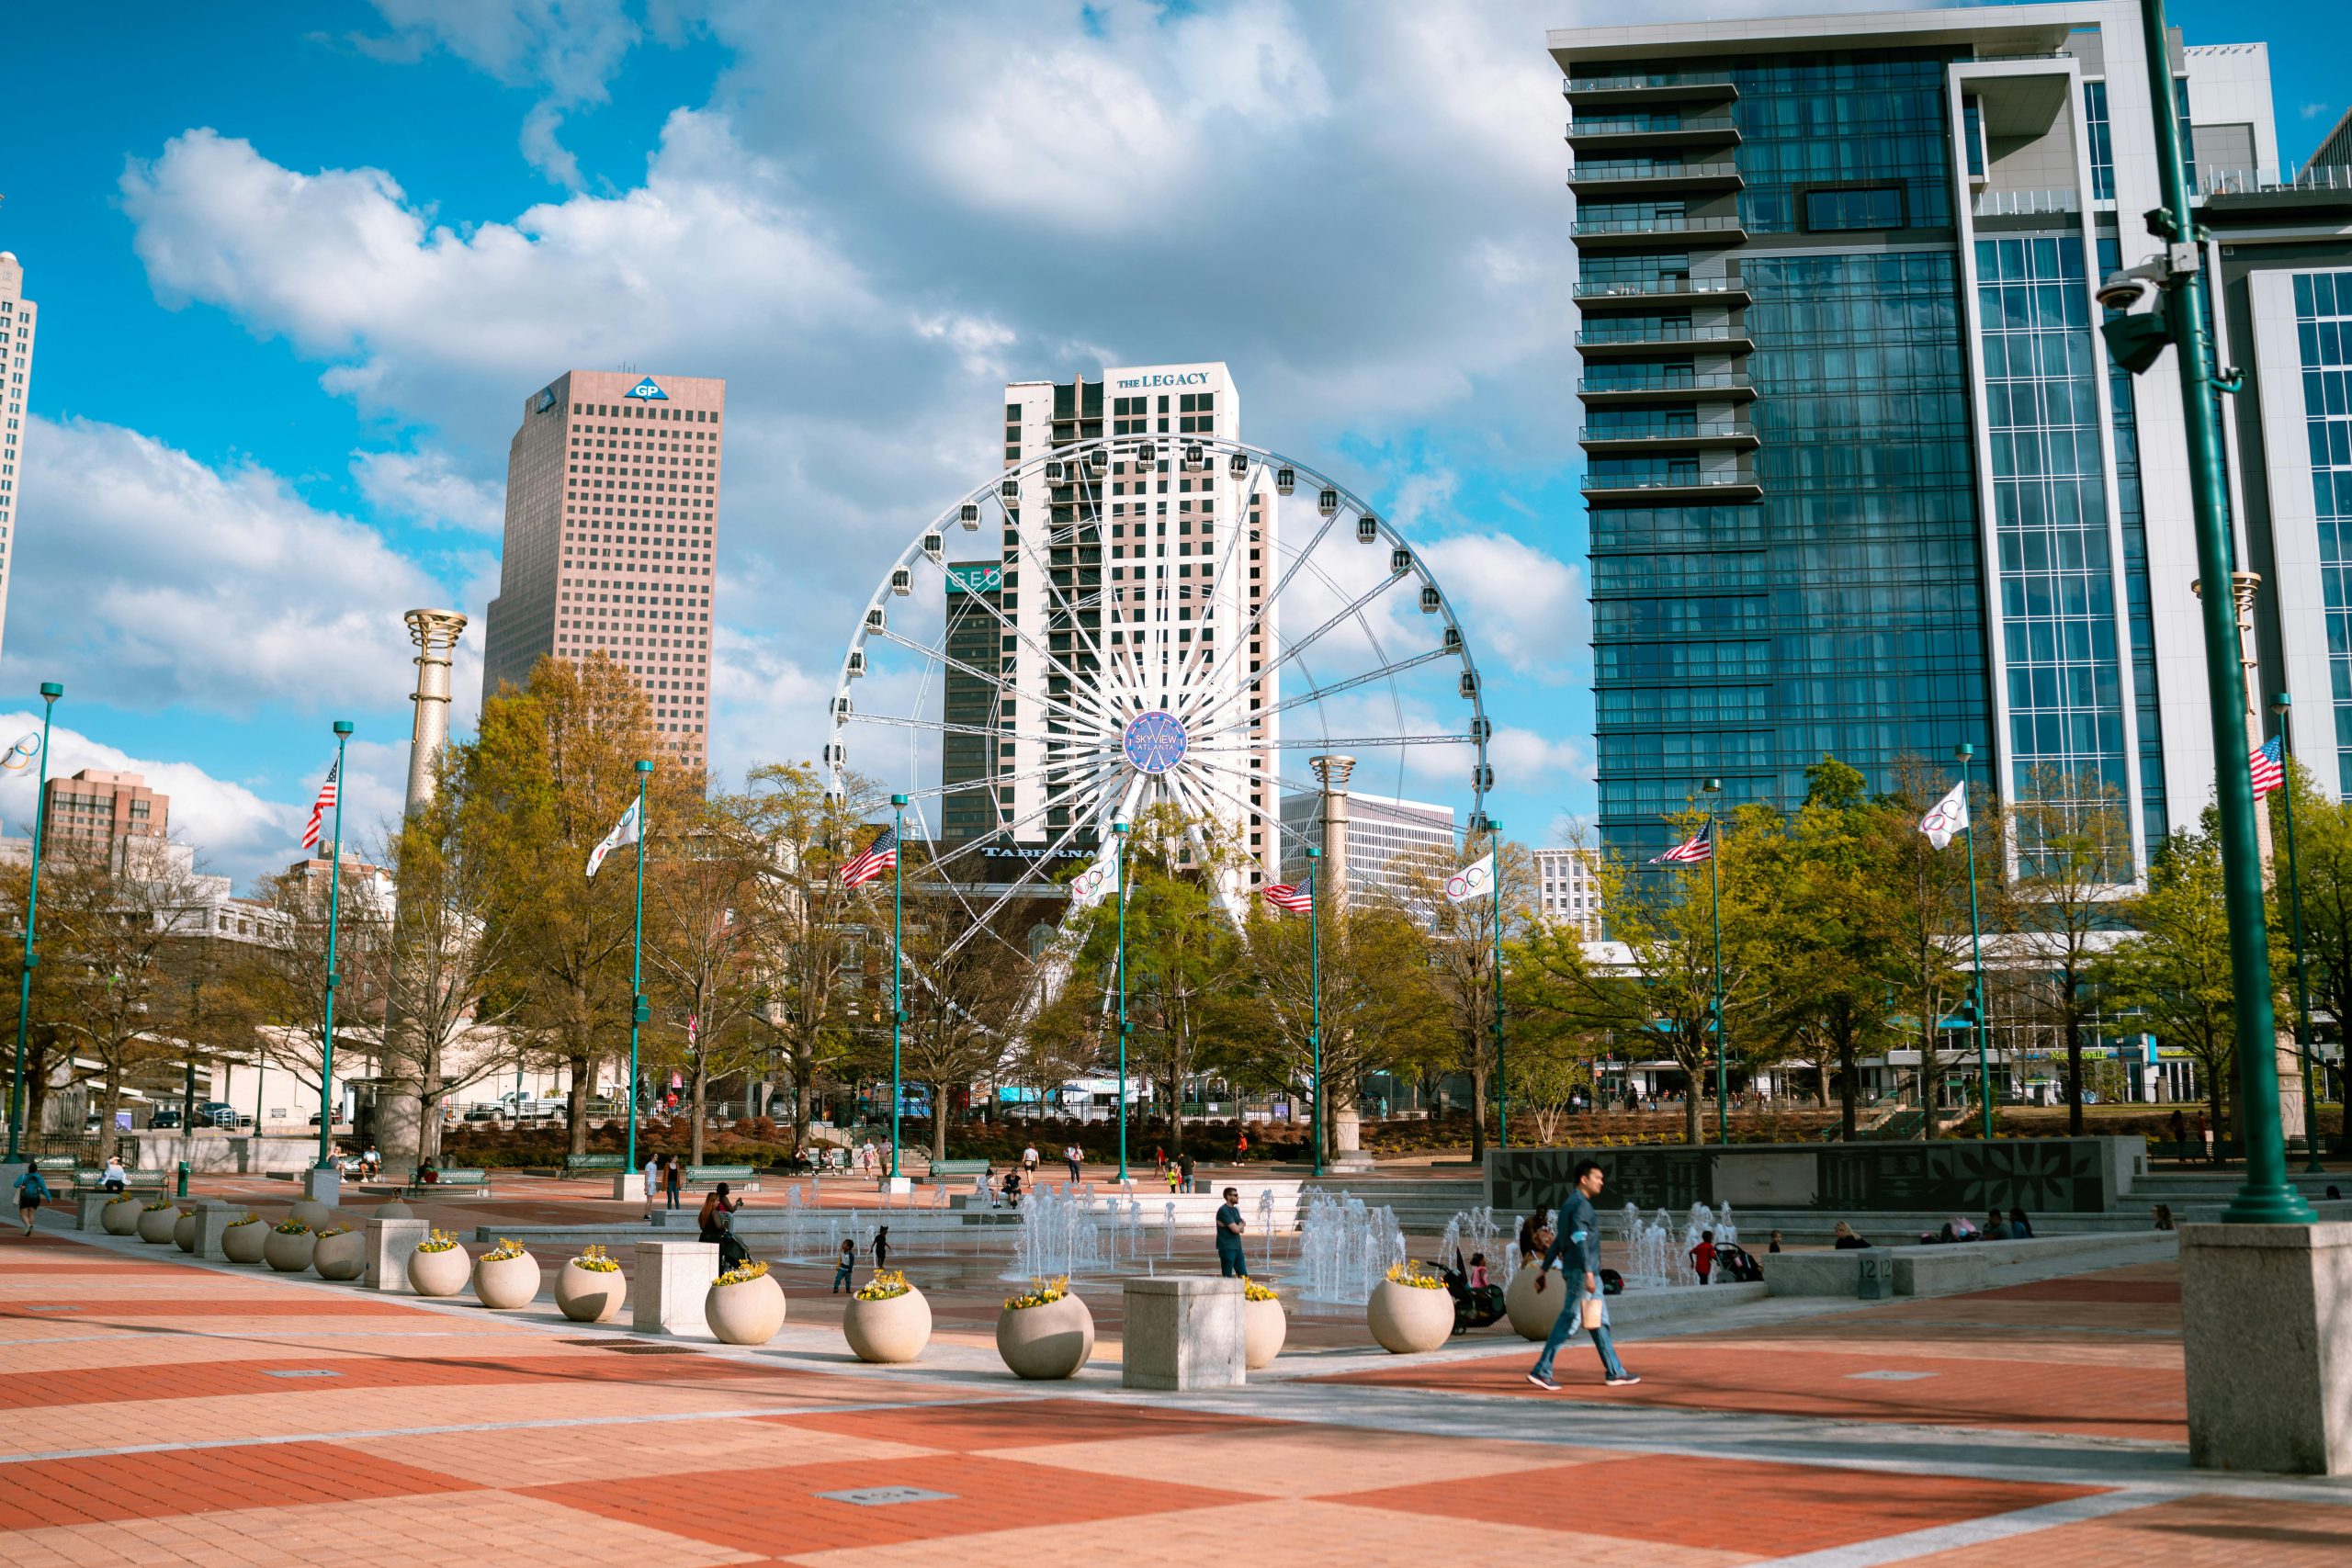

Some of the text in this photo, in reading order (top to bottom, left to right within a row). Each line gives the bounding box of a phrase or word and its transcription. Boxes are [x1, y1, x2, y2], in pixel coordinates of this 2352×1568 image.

[1117, 372, 1209, 389] THE LEGACY
[636, 385, 659, 396] GP
[951, 570, 1001, 588] GEO
[1136, 735, 1177, 744] SKYVIEW
[1860, 1259, 1876, 1279] 12
[1880, 1259, 1892, 1279] 12
